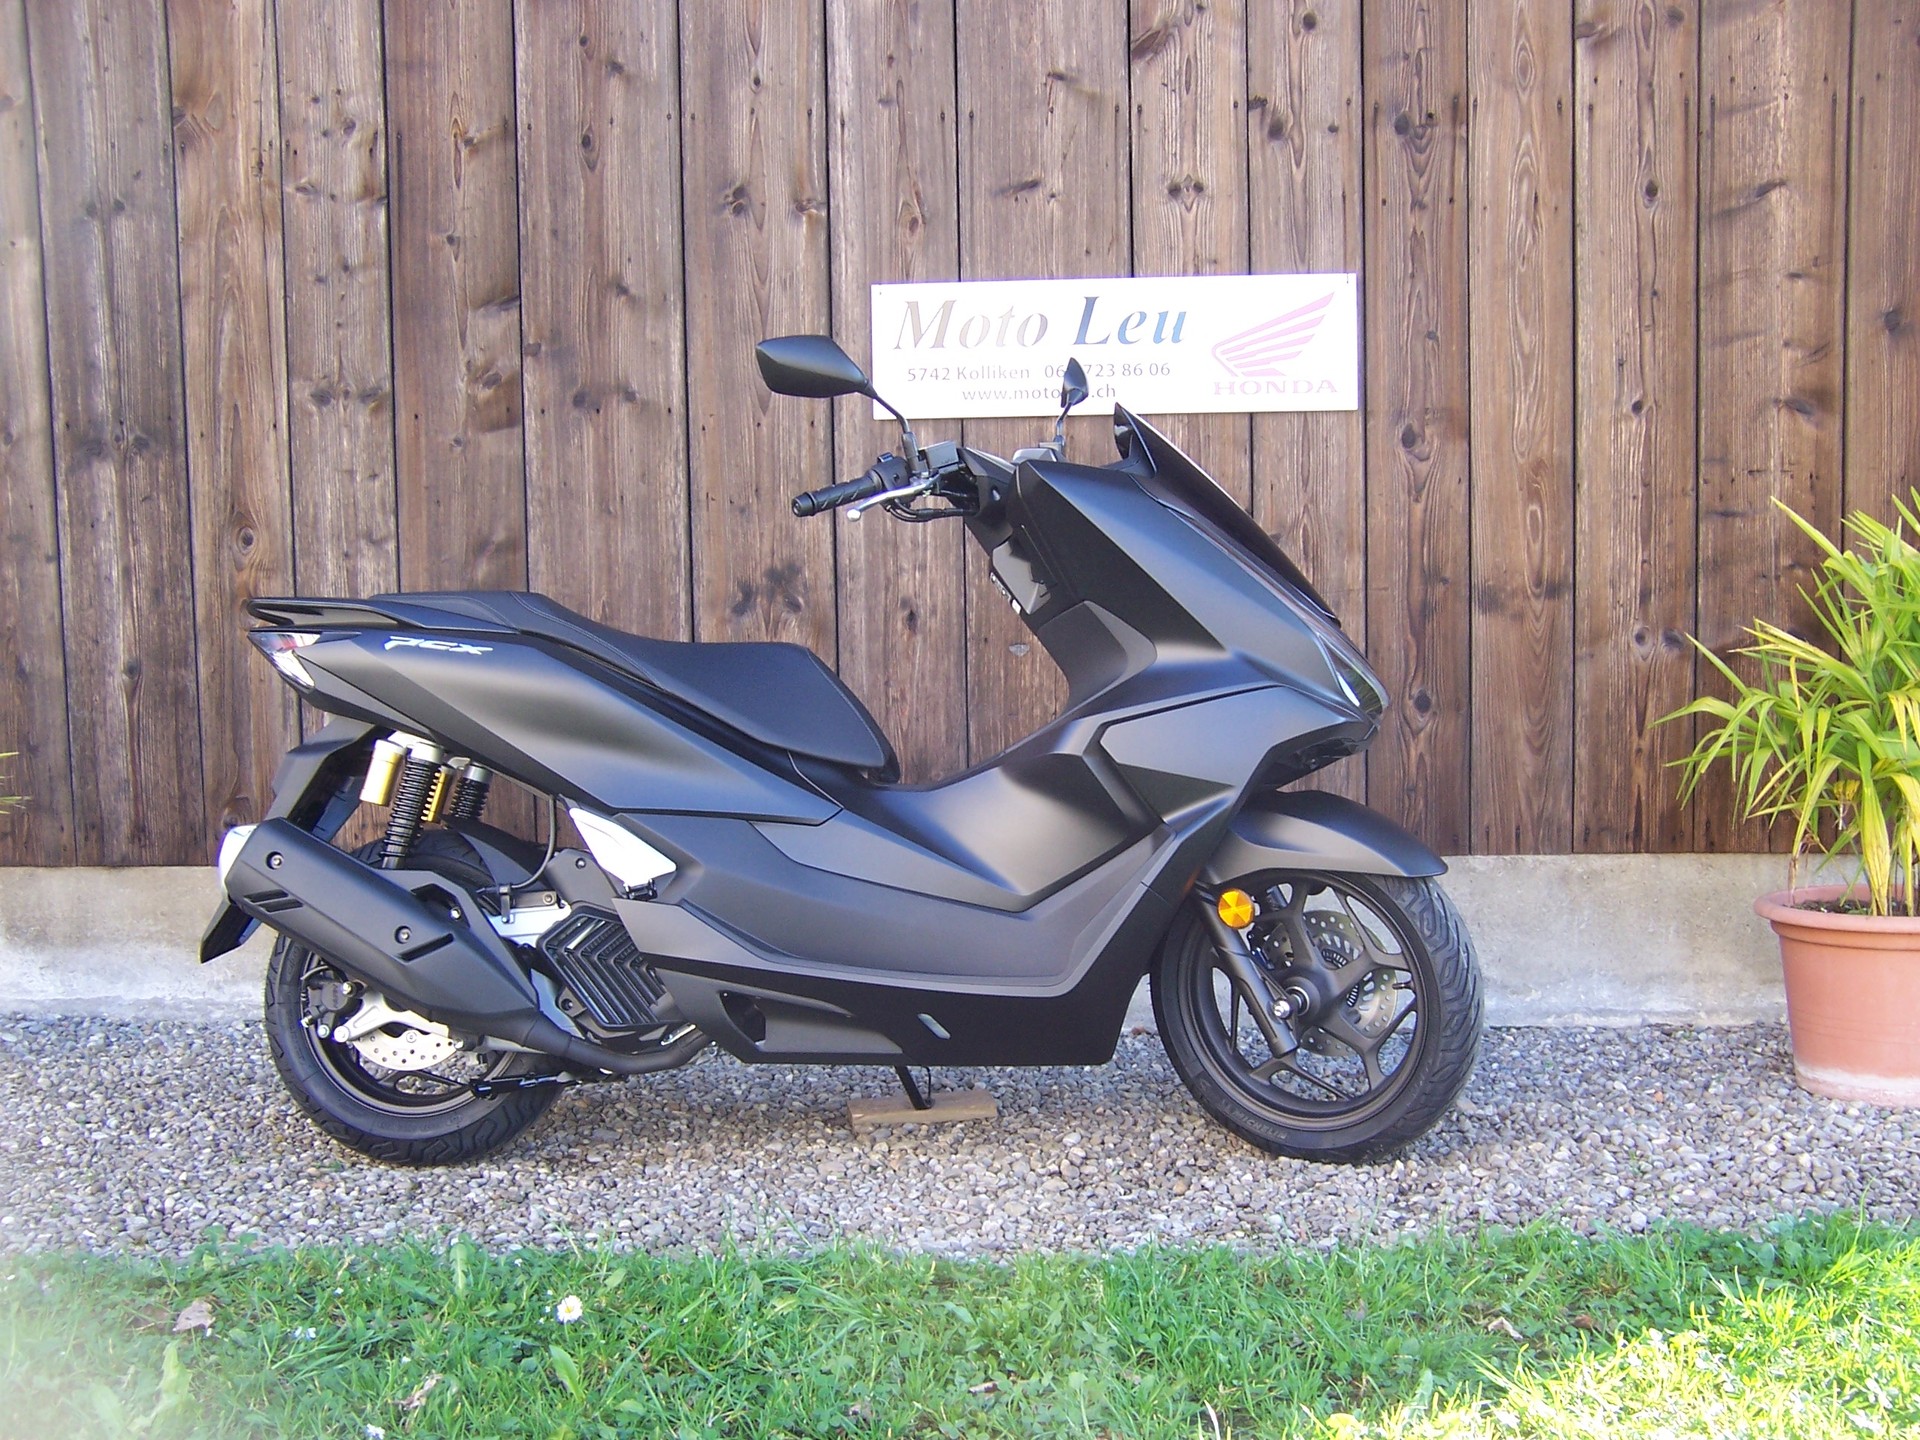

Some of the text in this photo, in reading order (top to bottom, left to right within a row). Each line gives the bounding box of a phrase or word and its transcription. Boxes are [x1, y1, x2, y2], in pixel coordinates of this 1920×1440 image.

[892, 296, 1187, 350] Moto Leu
[907, 366, 950, 382] 5742
[1044, 364, 1074, 378] 06
[1081, 363, 1115, 378] 723
[1121, 362, 1143, 377] 86
[1149, 362, 1170, 376] 06
[962, 384, 1116, 400] www.moto.ch
[1214, 379, 1338, 396] HONDA
[384, 635, 494, 655] PCX
